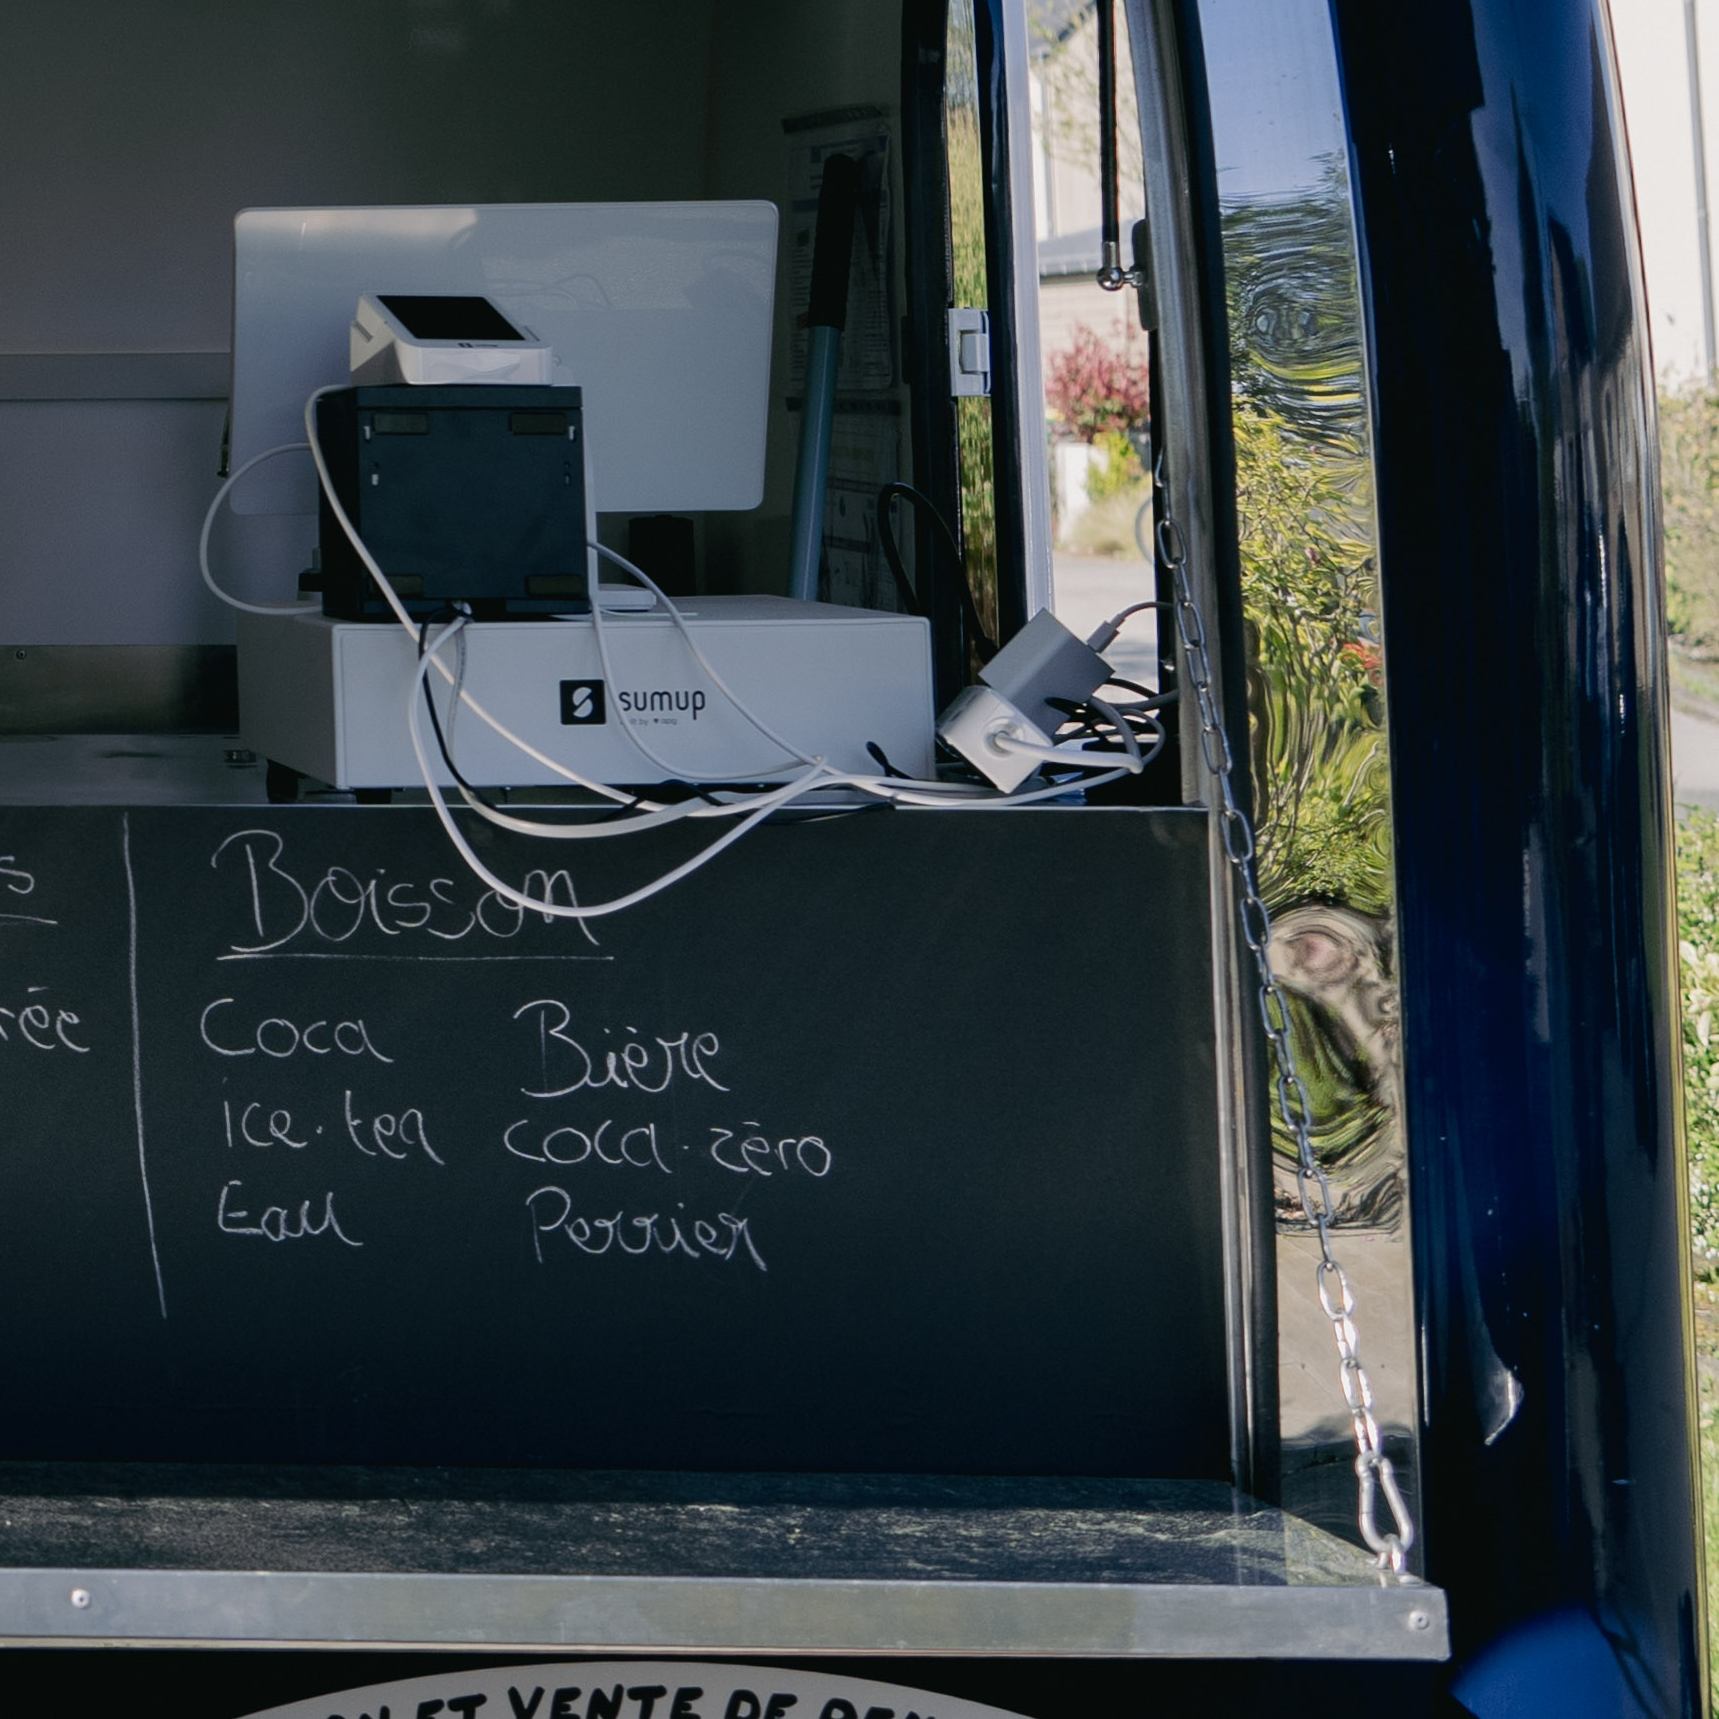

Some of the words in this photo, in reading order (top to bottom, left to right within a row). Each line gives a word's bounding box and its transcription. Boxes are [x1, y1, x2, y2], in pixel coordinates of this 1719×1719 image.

[618, 690, 705, 720] sumup
[210, 829, 600, 951] Boisson
[200, 998, 394, 1062] Coca
[513, 999, 729, 1096] Bière
[218, 1181, 362, 1247] Eau
[525, 1185, 767, 1272] Perrier
[507, 1683, 704, 1719] VENTE
